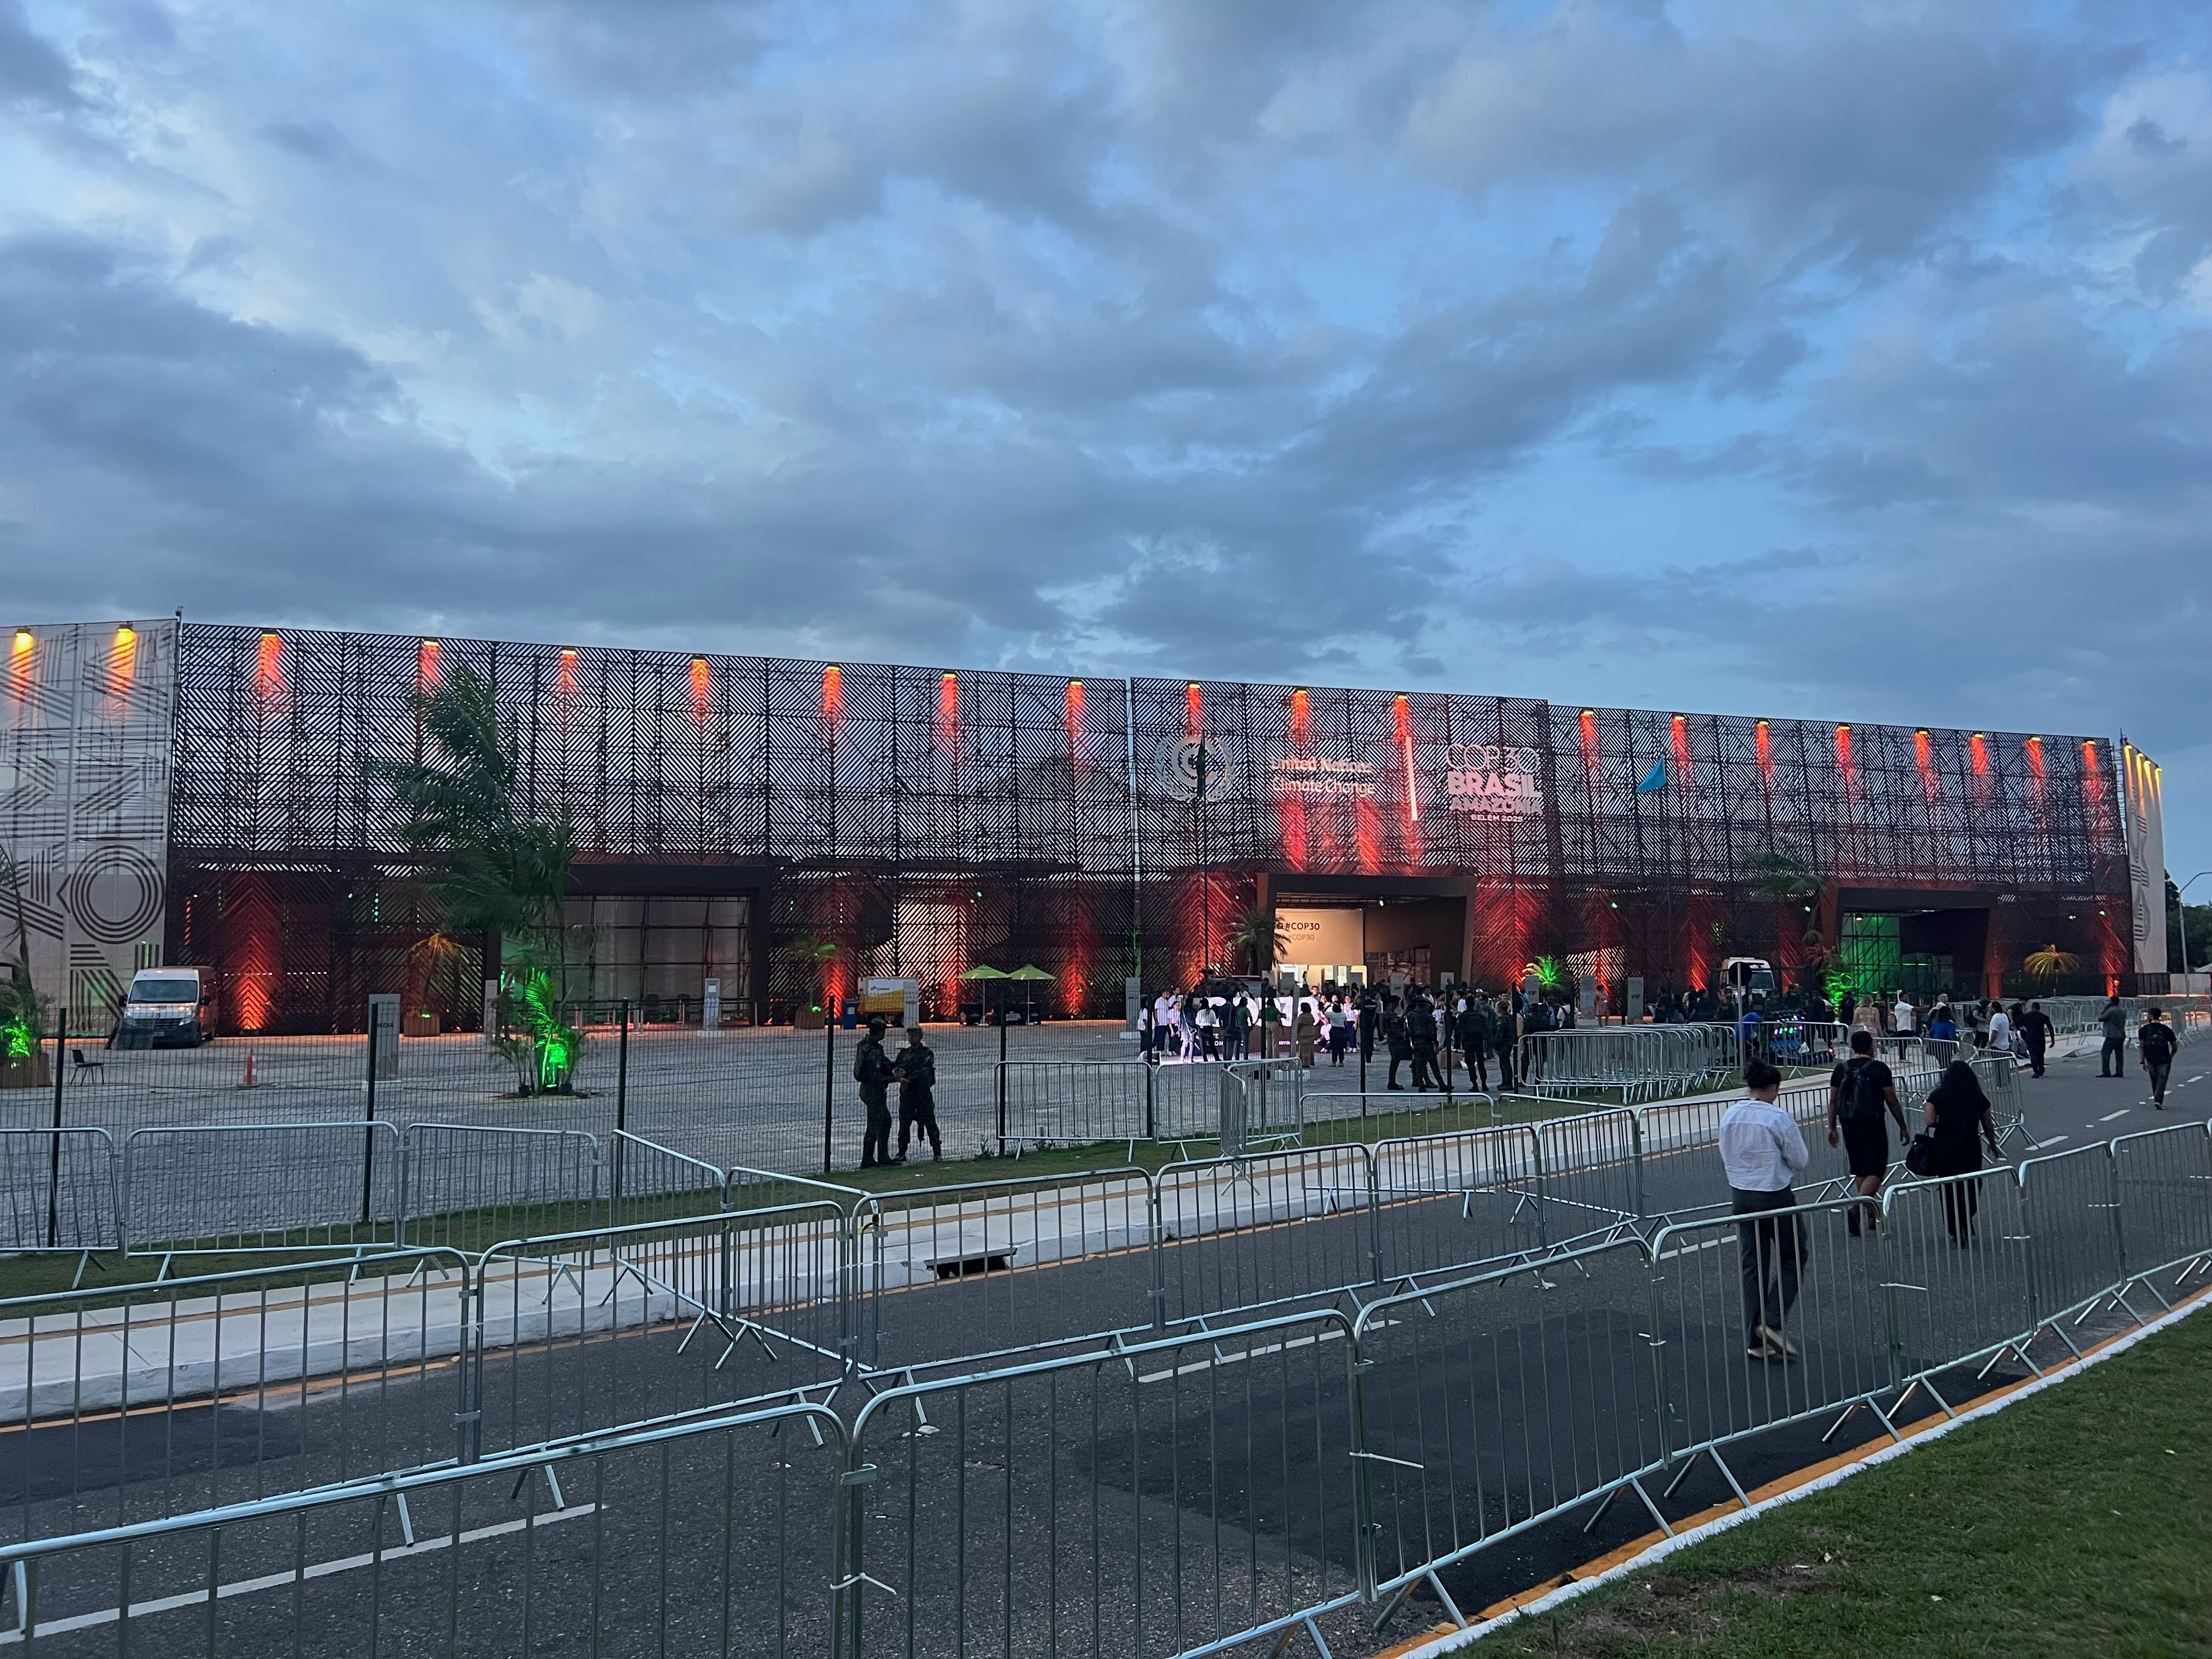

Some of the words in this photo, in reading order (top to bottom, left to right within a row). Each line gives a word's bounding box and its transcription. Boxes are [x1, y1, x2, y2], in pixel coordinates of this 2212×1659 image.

[1272, 755, 1317, 771] United
[1321, 758, 1373, 773] Nations
[1446, 743, 1500, 770] COP
[1502, 747, 1539, 773] 30
[1273, 776, 1322, 792] Climate
[1325, 778, 1375, 797] Change
[1447, 771, 1543, 798] BRASIL
